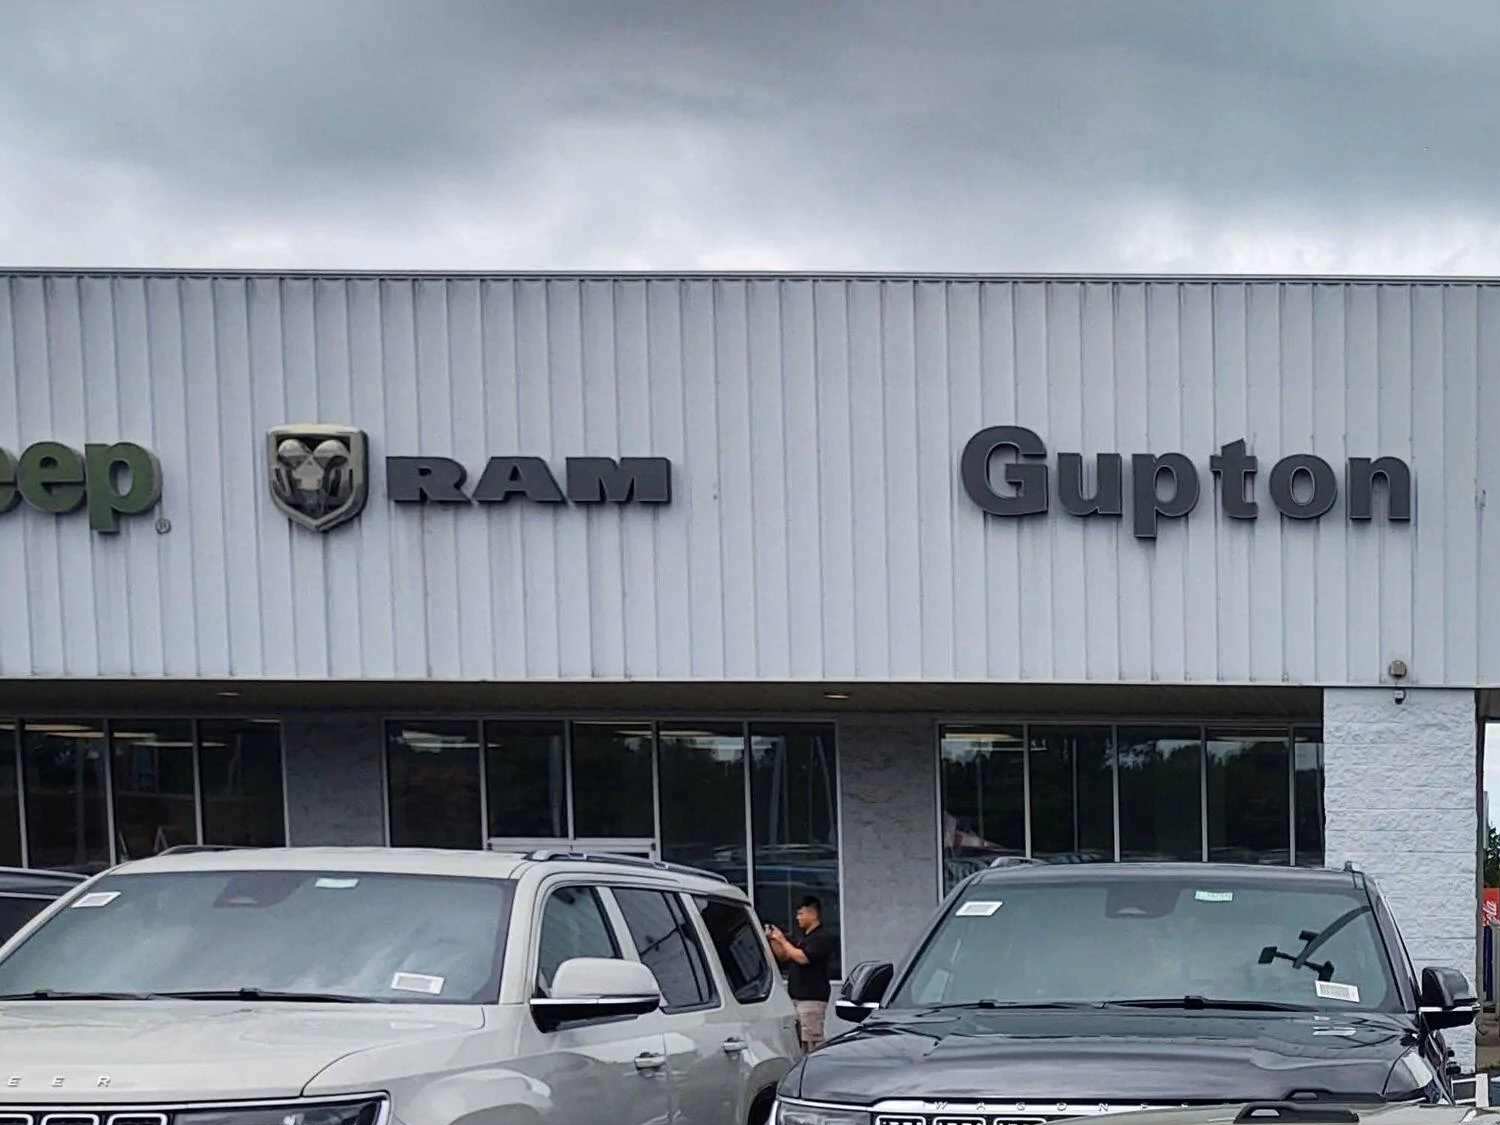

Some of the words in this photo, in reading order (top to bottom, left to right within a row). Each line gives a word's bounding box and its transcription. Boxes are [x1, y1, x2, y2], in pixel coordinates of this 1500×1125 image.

[0, 441, 163, 534] ep
[386, 455, 672, 504] RAM
[961, 425, 1412, 539] Gupton
